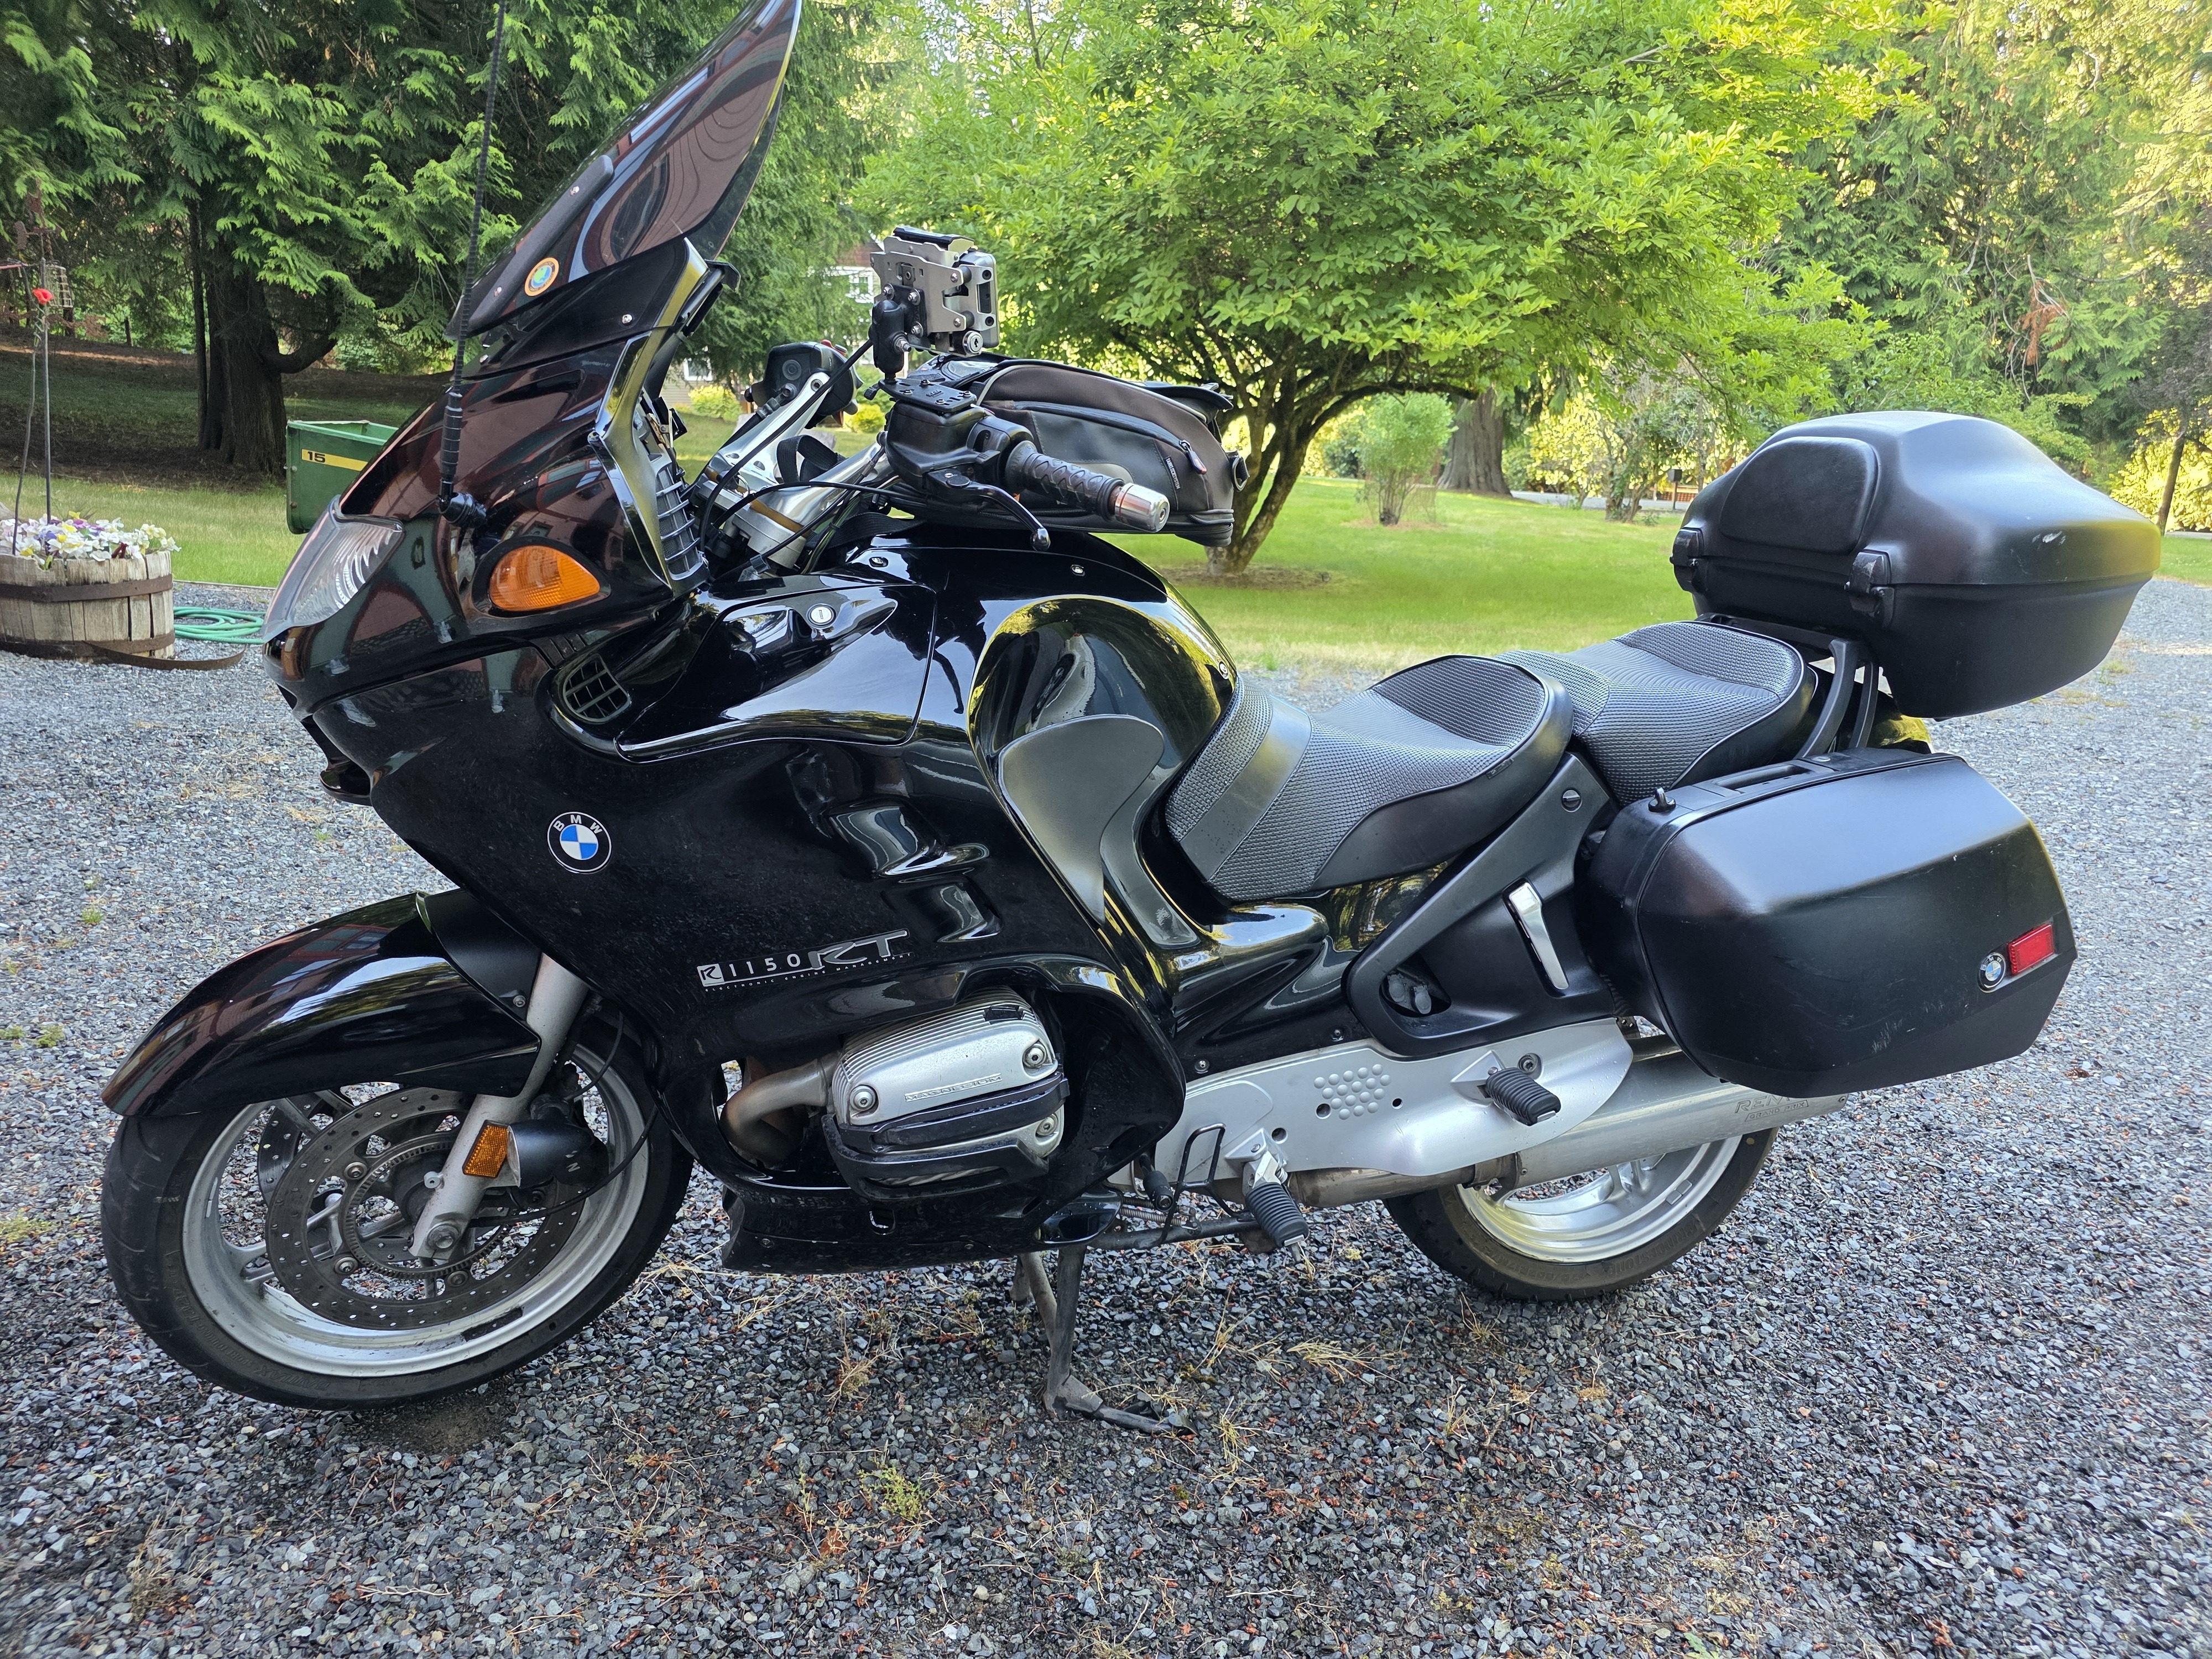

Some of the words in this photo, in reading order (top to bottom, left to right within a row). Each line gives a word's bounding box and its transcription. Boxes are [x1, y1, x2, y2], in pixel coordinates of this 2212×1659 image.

[307, 451, 326, 463] 15
[553, 815, 603, 834] BMW
[705, 979, 774, 992] ELECTRONIC
[785, 971, 826, 980] ENGINE
[836, 953, 911, 971] MANAGEMENT
[1750, 1108, 1780, 1119] GRAND
[1784, 1102, 1804, 1111] PRIX
